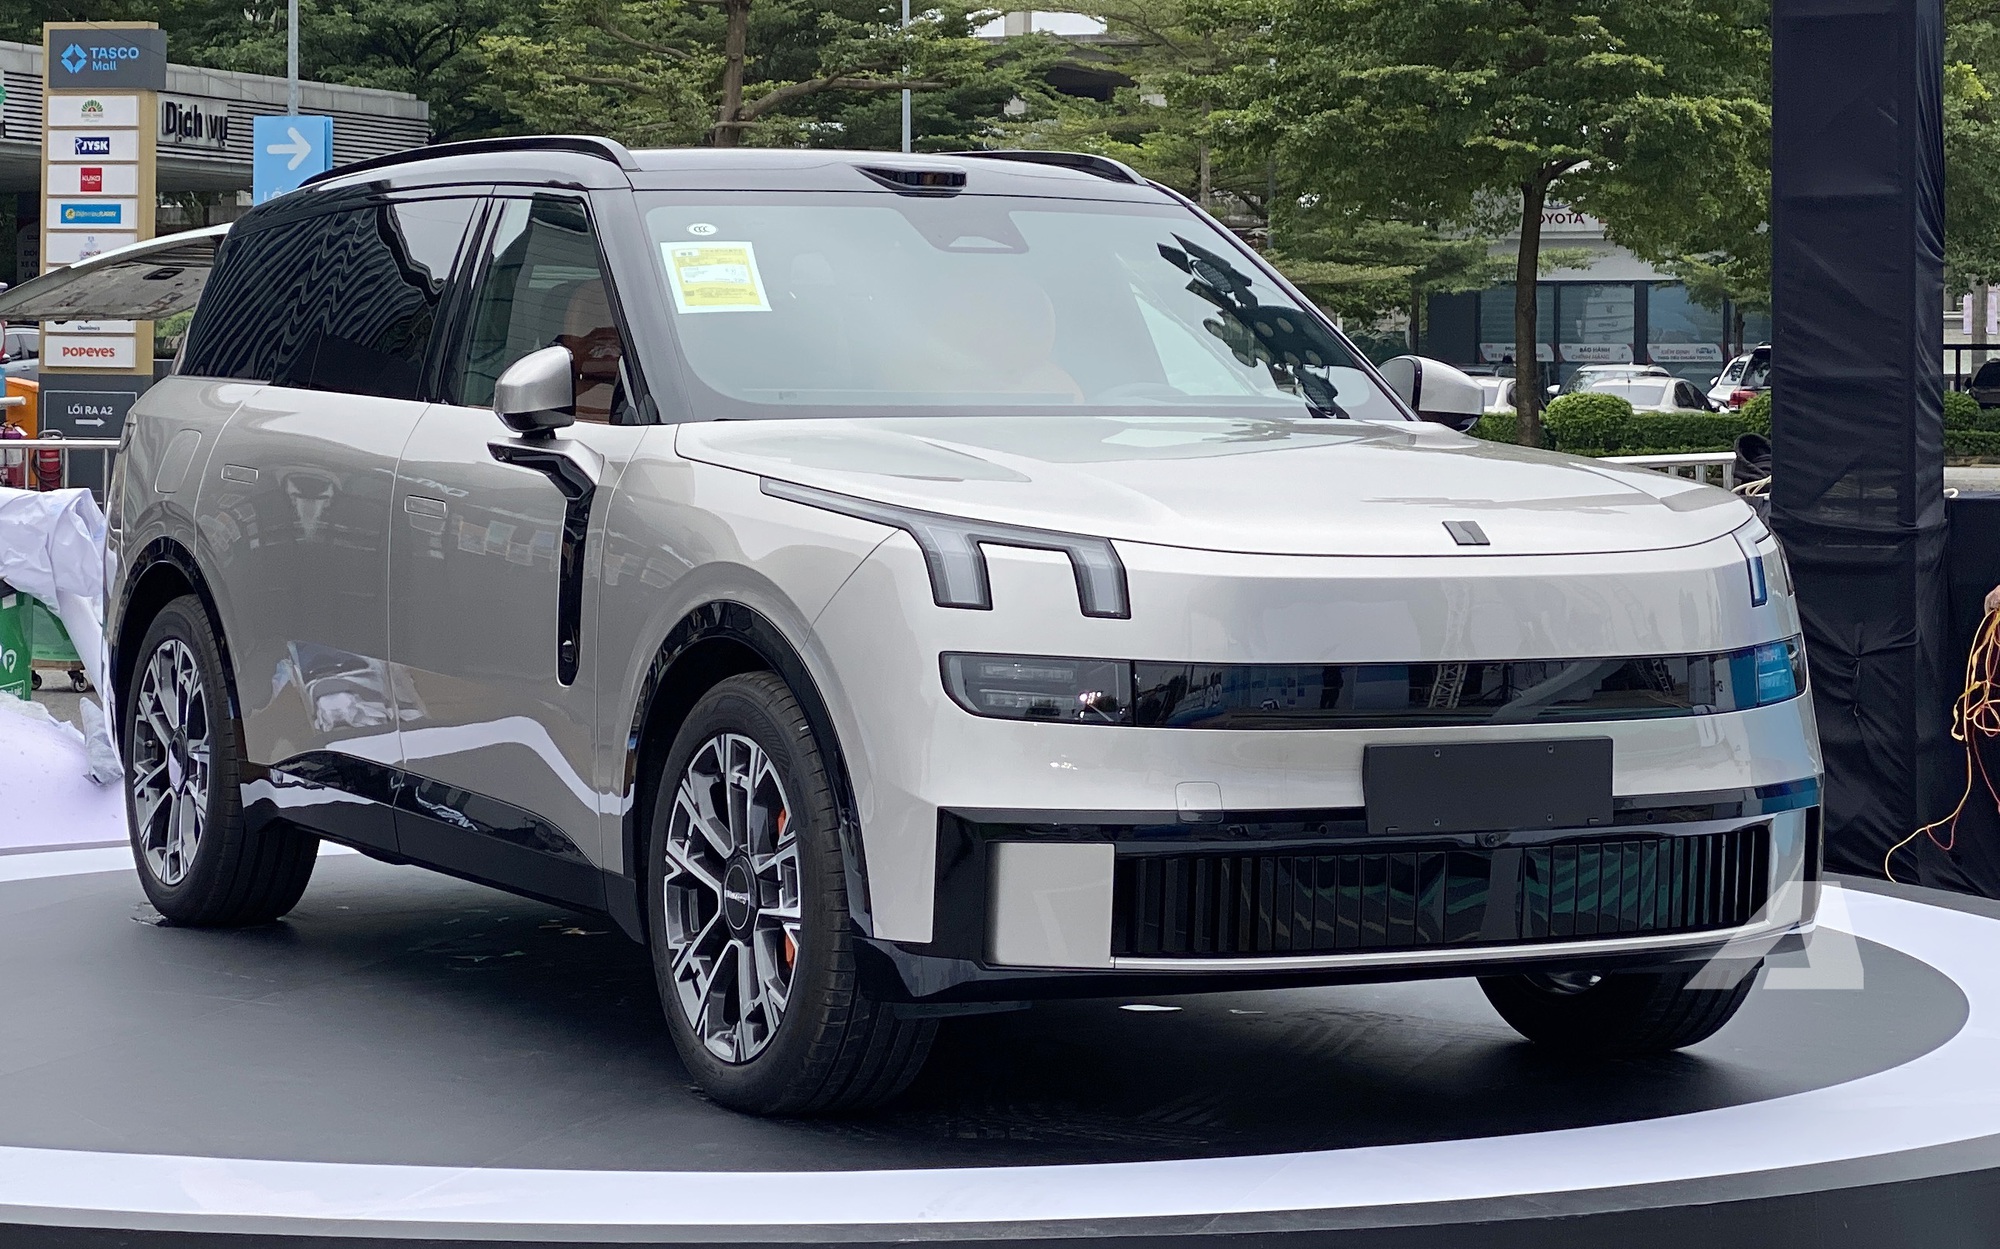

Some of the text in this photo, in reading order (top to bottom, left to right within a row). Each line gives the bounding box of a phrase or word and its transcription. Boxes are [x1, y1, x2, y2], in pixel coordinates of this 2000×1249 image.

[90, 47, 139, 59] TASCO
[92, 61, 117, 71] Mall
[162, 101, 202, 143] Dịch
[81, 141, 108, 150] JYSK
[67, 403, 113, 415] LỐI RA A2
